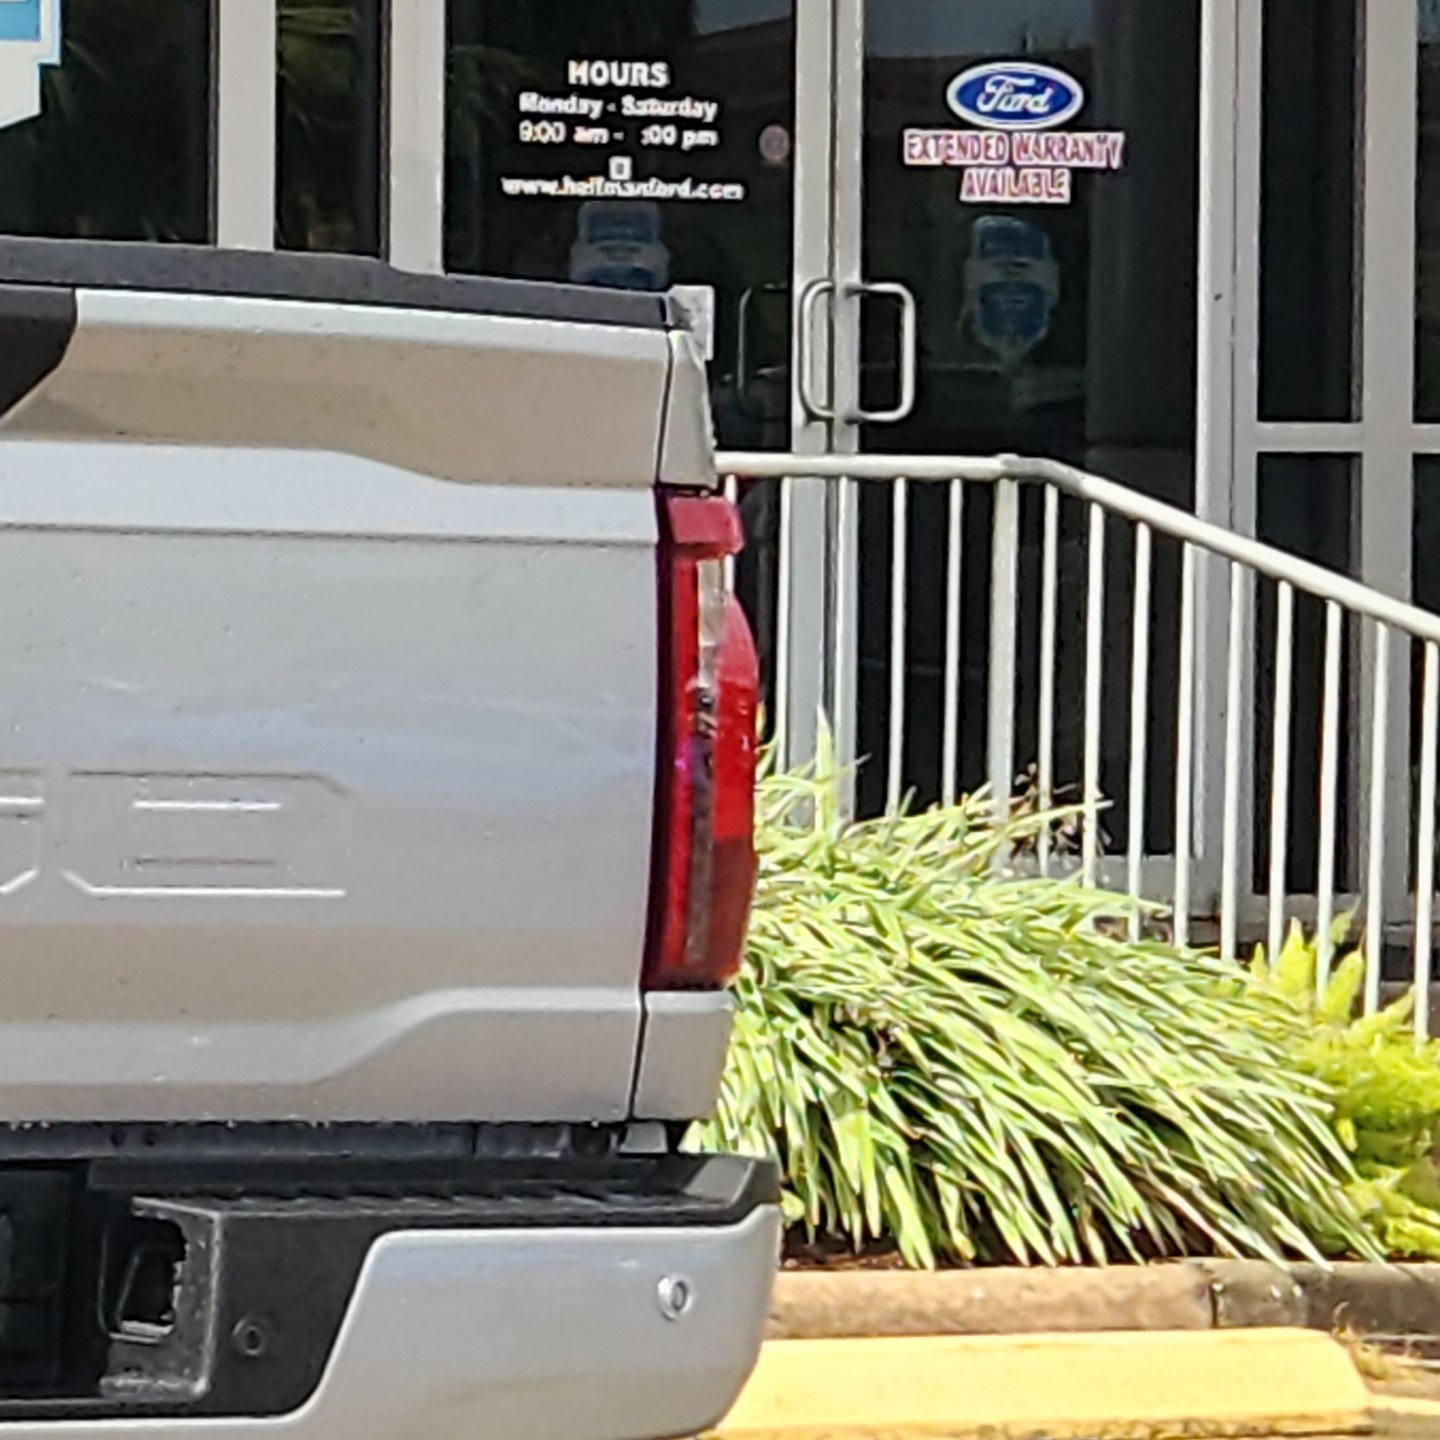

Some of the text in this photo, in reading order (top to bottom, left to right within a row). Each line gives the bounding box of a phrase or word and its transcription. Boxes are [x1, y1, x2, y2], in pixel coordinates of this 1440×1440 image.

[567, 60, 670, 87] HOURS
[519, 92, 603, 120] Monday
[621, 94, 718, 122] Saturday
[976, 74, 1055, 113] Ford
[519, 120, 566, 144] 9:00
[573, 126, 610, 144] am
[682, 130, 719, 150] pm
[906, 131, 1122, 167] EXTENDED WARRANTY
[963, 168, 1067, 200] AVAILABLE
